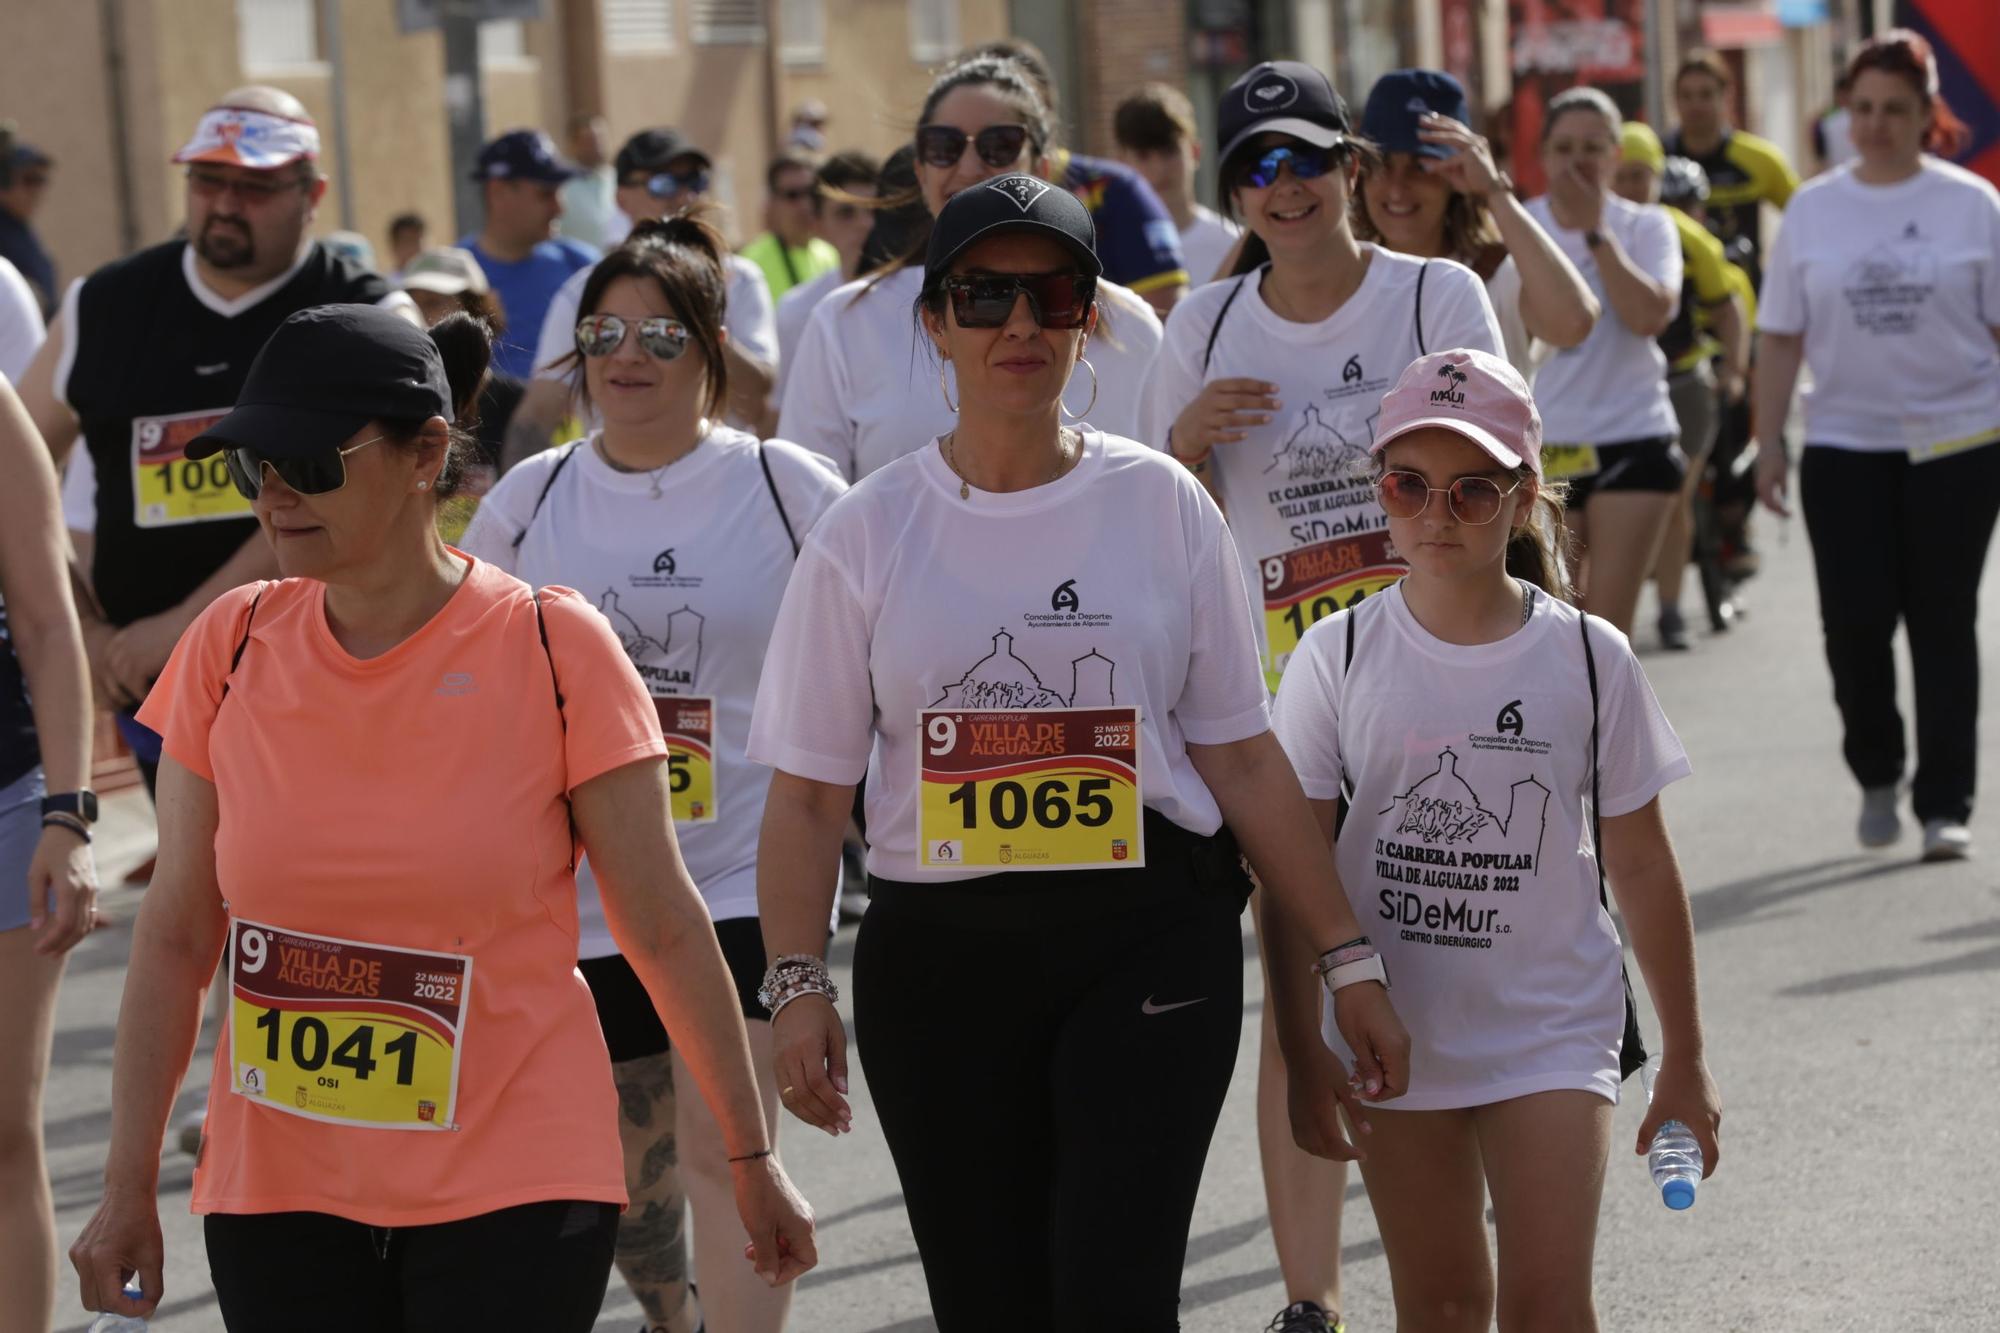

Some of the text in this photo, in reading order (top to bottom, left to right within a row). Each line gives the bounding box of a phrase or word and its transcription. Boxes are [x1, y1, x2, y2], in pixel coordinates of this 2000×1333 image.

[999, 179, 1042, 190] GUESS
[1430, 390, 1465, 404] MAUI
[1284, 479, 1347, 500] CARRERA
[1278, 504, 1308, 519] VILLA
[1309, 501, 1324, 514] DE
[1077, 612, 1112, 622] Deportes
[969, 714, 1029, 722] CARRERA POPULAR
[969, 722, 1066, 742] VILLA DE
[1094, 724, 1130, 734] 22 MAYO
[969, 739, 1066, 756] ALGUAZAS
[1094, 734, 1130, 748] 2022
[1508, 736, 1519, 745] de
[1520, 737, 1552, 749] Deportes
[949, 778, 1114, 830] 1065
[1014, 852, 1050, 860] ALGUAZAS
[1386, 841, 1458, 868] CARRERA
[1460, 852, 1533, 870] POPULAR
[1376, 860, 1520, 892] VILLA DE ALGUAZAS 2022
[1379, 888, 1499, 933] SiDeMur
[279, 935, 342, 953] CARRERA POPULAR
[1400, 929, 1492, 949] CENTRO SIDERÚRGICO
[278, 944, 383, 982] VILLA DE
[277, 966, 379, 998] ALGUAZAS
[414, 972, 458, 986] 22 MAYO
[413, 983, 456, 1001] 2022
[256, 1008, 418, 1086] 1041
[317, 1076, 339, 1089] OSI
